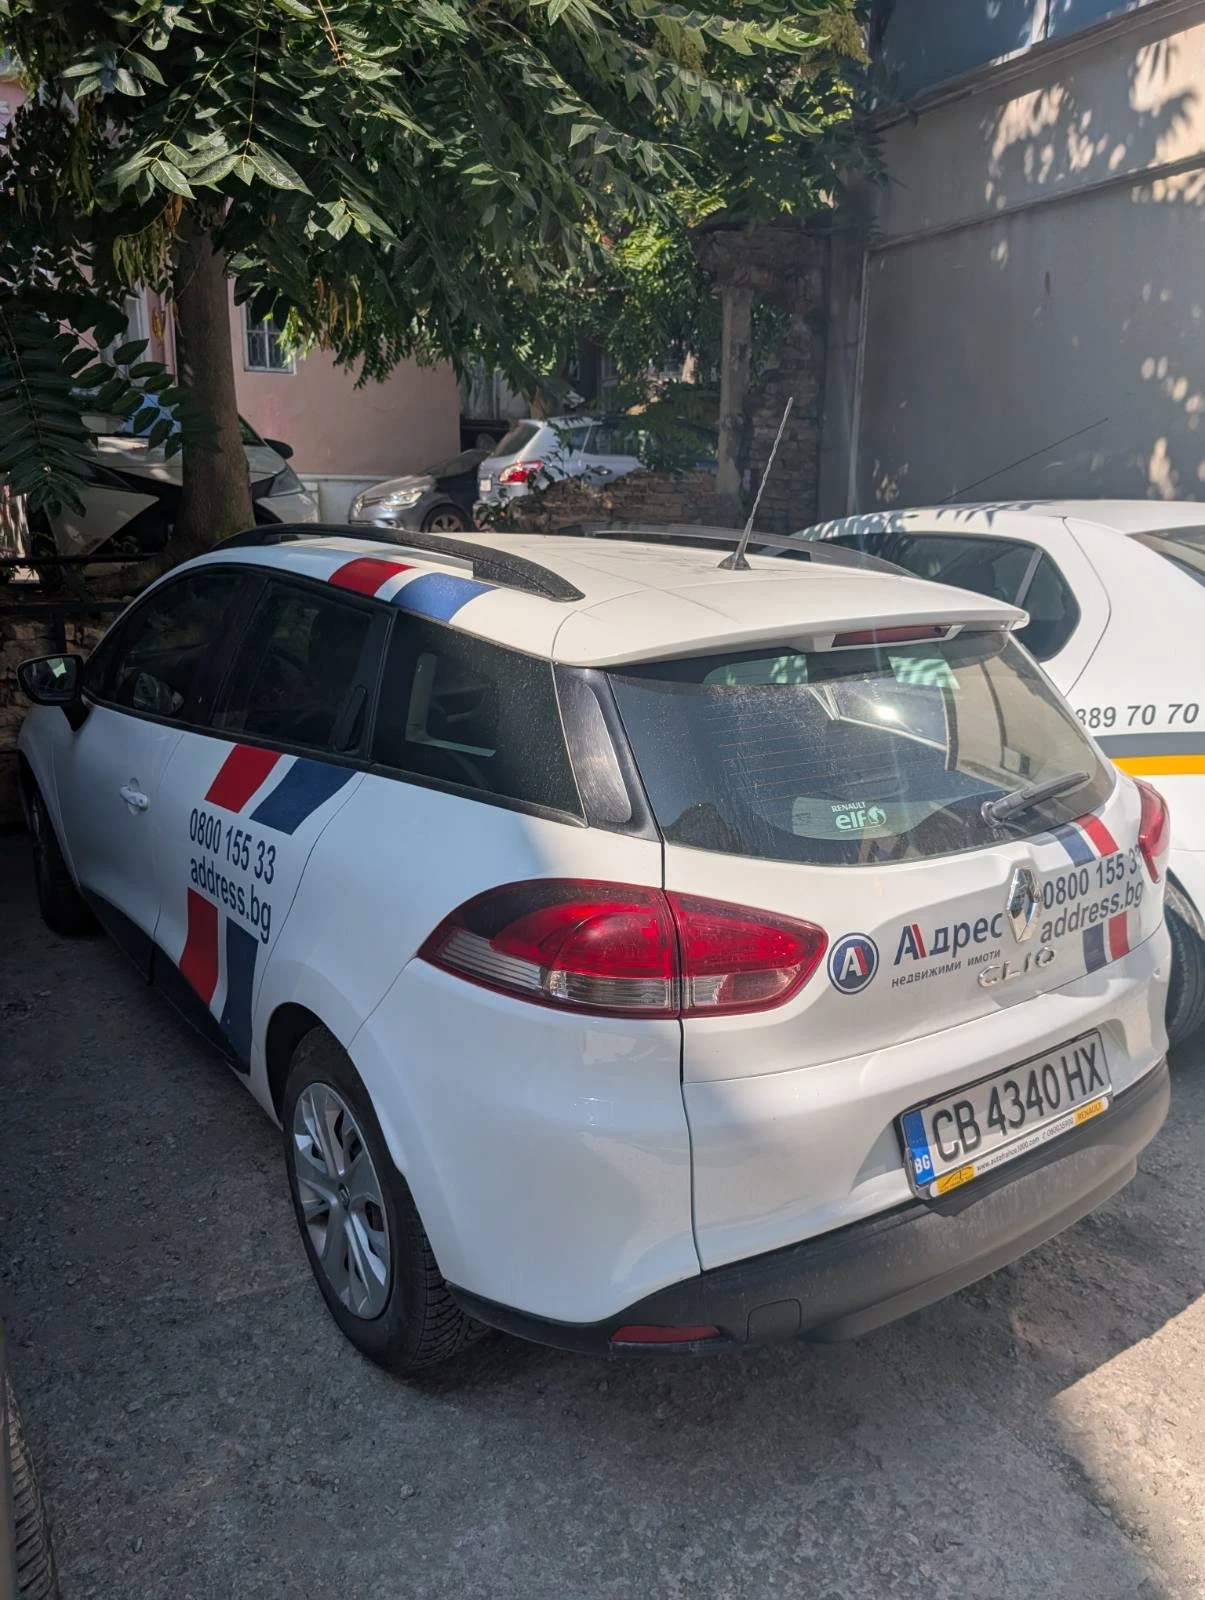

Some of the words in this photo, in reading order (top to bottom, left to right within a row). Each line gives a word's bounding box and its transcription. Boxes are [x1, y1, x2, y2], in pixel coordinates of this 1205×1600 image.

[1127, 704, 1156, 726] 70
[1167, 703, 1200, 724] 70
[831, 801, 866, 812] RENAULT
[835, 810, 867, 830] elf
[189, 808, 222, 854] 0800
[226, 825, 252, 871] 155
[254, 839, 277, 884] 33
[190, 856, 272, 945] address.bg
[1043, 868, 1089, 909] 0800
[1096, 853, 1124, 888] 155
[1040, 880, 1144, 943] address.bg
[893, 912, 1003, 966] Адрес
[891, 960, 962, 988] недвижими
[967, 949, 1001, 967] имоти
[977, 945, 1057, 988] CLIO
[987, 1063, 1061, 1136] 4340
[1077, 1101, 1102, 1121] RENAULT
[914, 1153, 931, 1174] BG
